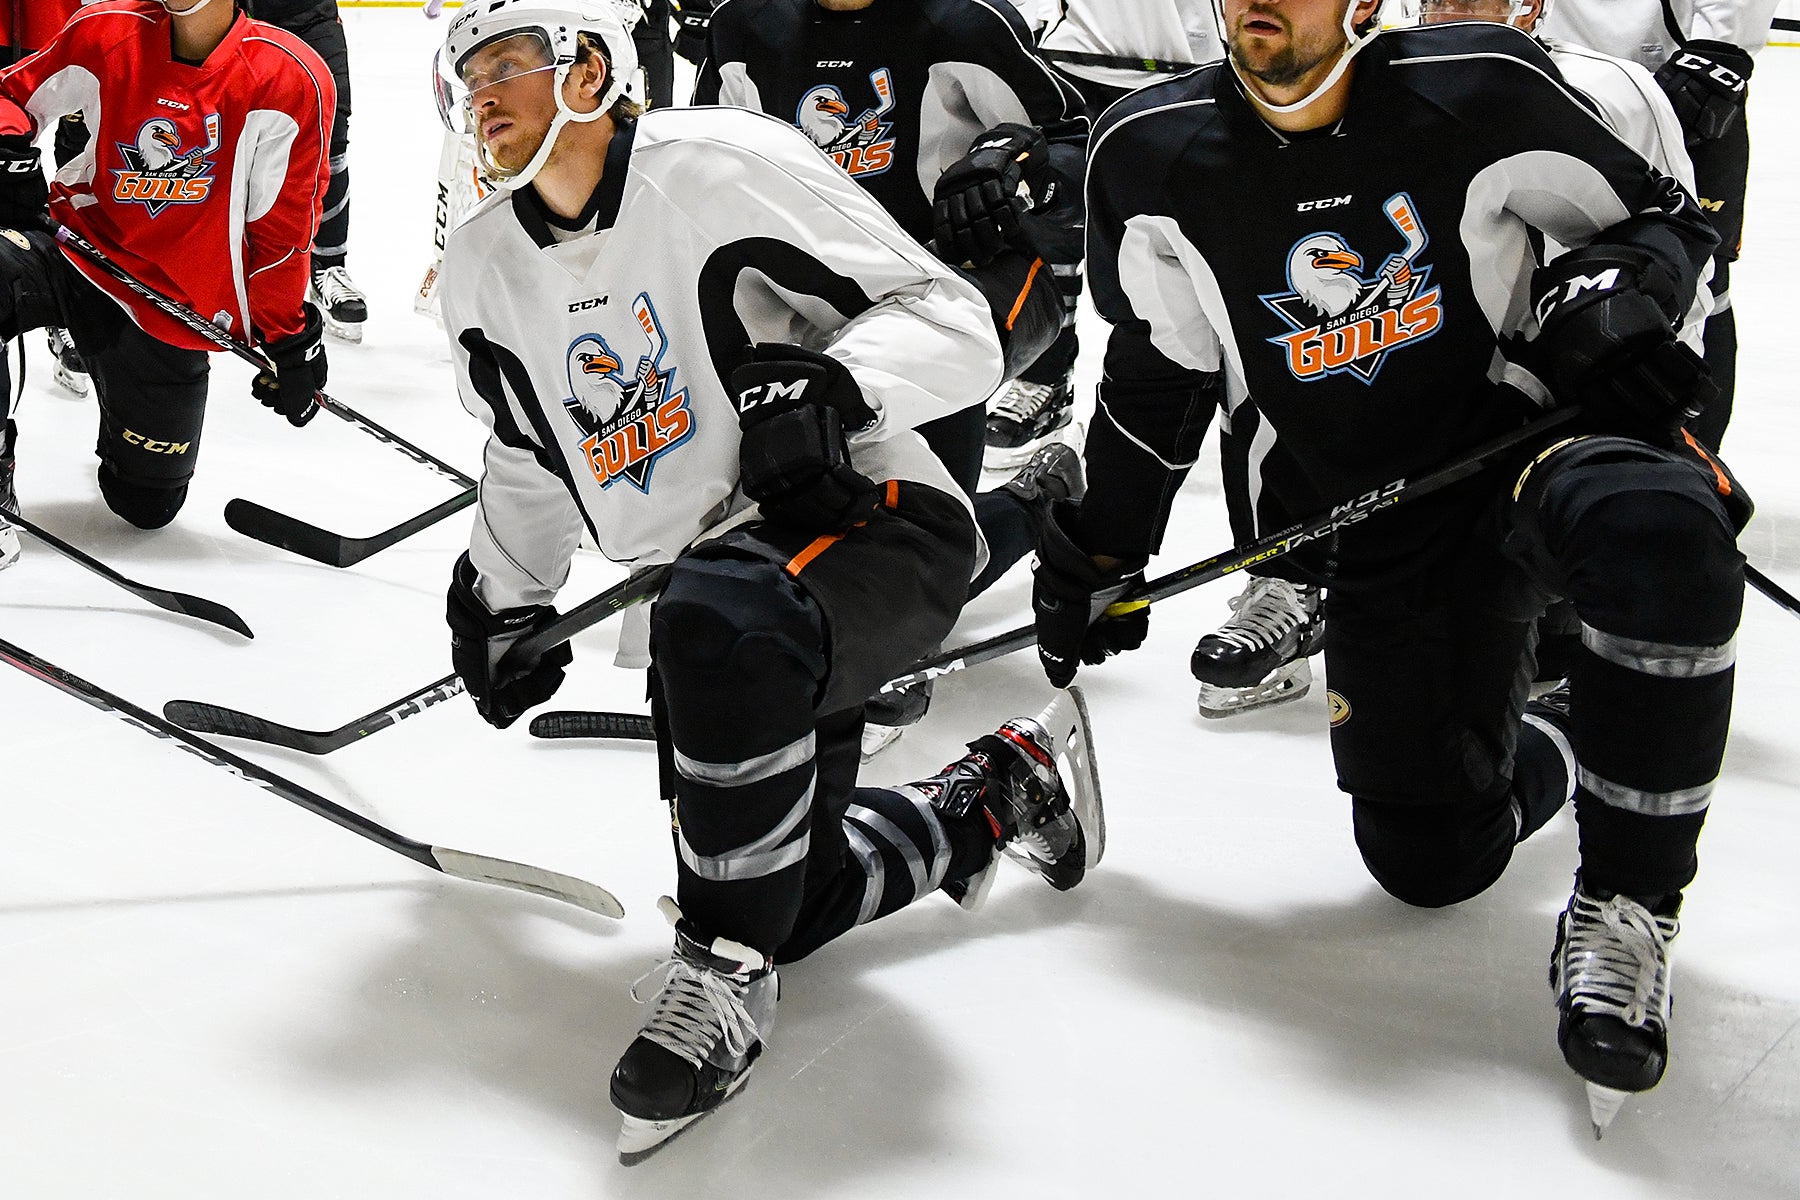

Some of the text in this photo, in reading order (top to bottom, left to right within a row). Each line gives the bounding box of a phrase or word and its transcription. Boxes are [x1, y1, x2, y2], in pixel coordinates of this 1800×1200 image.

[816, 60, 854, 68] CCM
[157, 97, 190, 111] CCM
[113, 170, 212, 201] GULLS
[434, 180, 449, 251] CCM
[1296, 194, 1353, 212] CCM
[112, 273, 235, 350] JETSPEED
[567, 295, 609, 314] CCM
[1325, 304, 1380, 330] SAN DIEGO
[1274, 288, 1440, 377] GULLS
[601, 408, 642, 438] SAN DIEGO
[122, 427, 191, 455] CCM
[577, 391, 692, 487] GULLS
[1330, 478, 1405, 520] CCM
[1222, 547, 1279, 574] SUPER
[1276, 510, 1368, 553] TACKS
